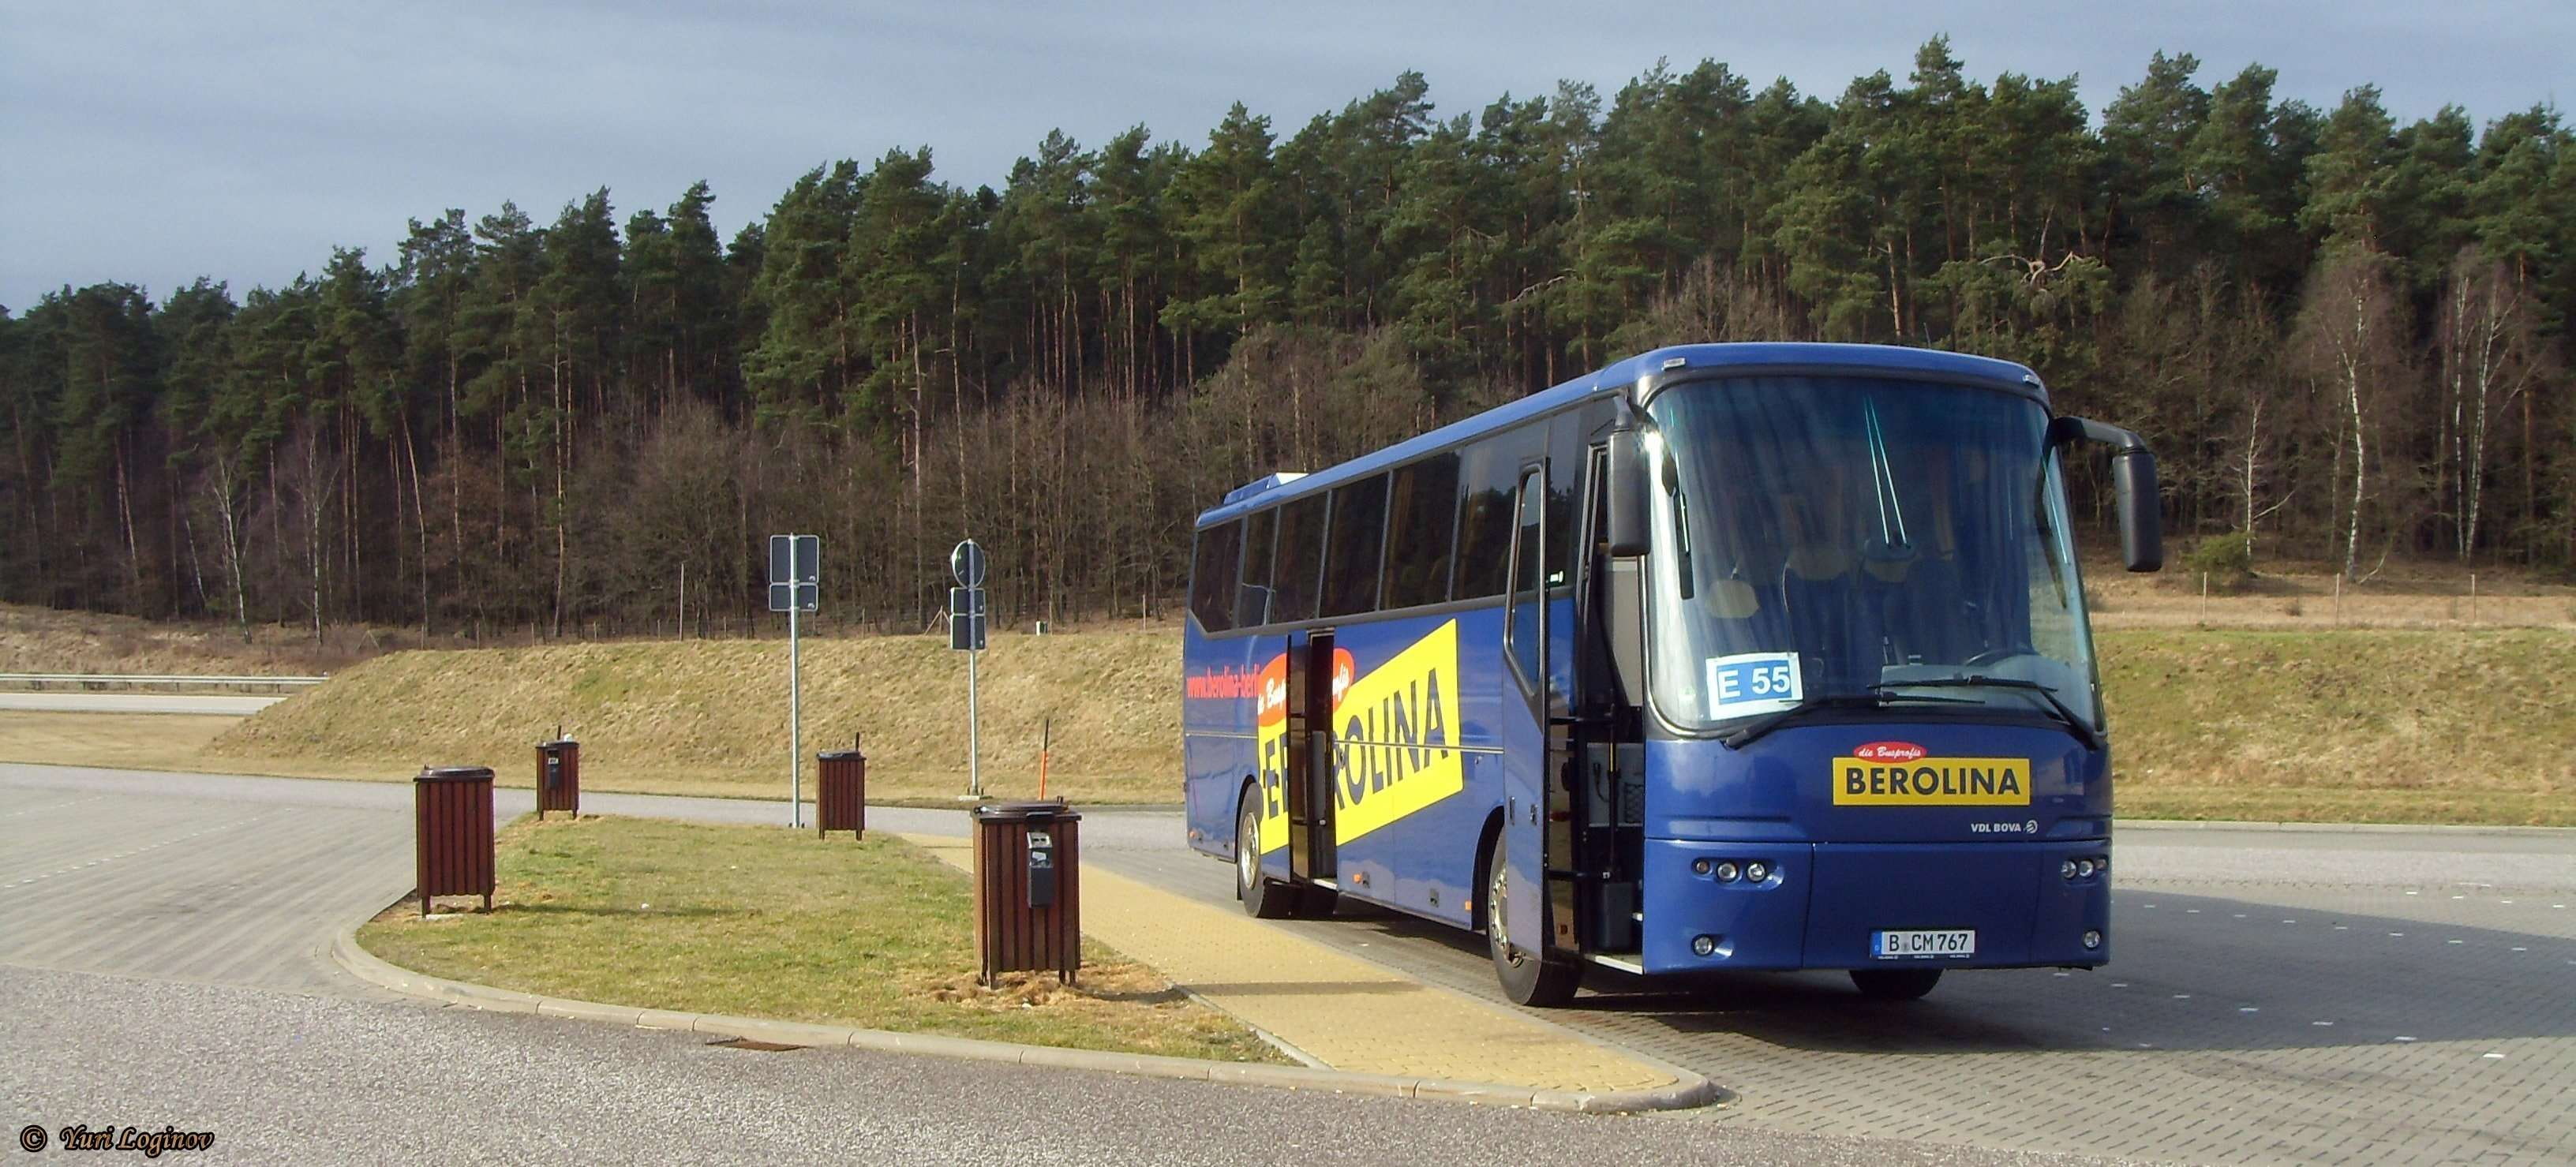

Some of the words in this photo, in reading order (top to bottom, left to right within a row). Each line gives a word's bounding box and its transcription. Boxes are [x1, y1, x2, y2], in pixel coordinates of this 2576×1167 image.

[1718, 669, 1741, 699] E
[1751, 666, 1791, 695] 55
[1859, 748, 1874, 757] die
[1877, 746, 1921, 759] Busprofis
[1845, 767, 2021, 795] BEROLINA
[1971, 823, 1991, 832] VDL
[1994, 823, 2022, 832] BOVA
[1889, 934, 1900, 952] B
